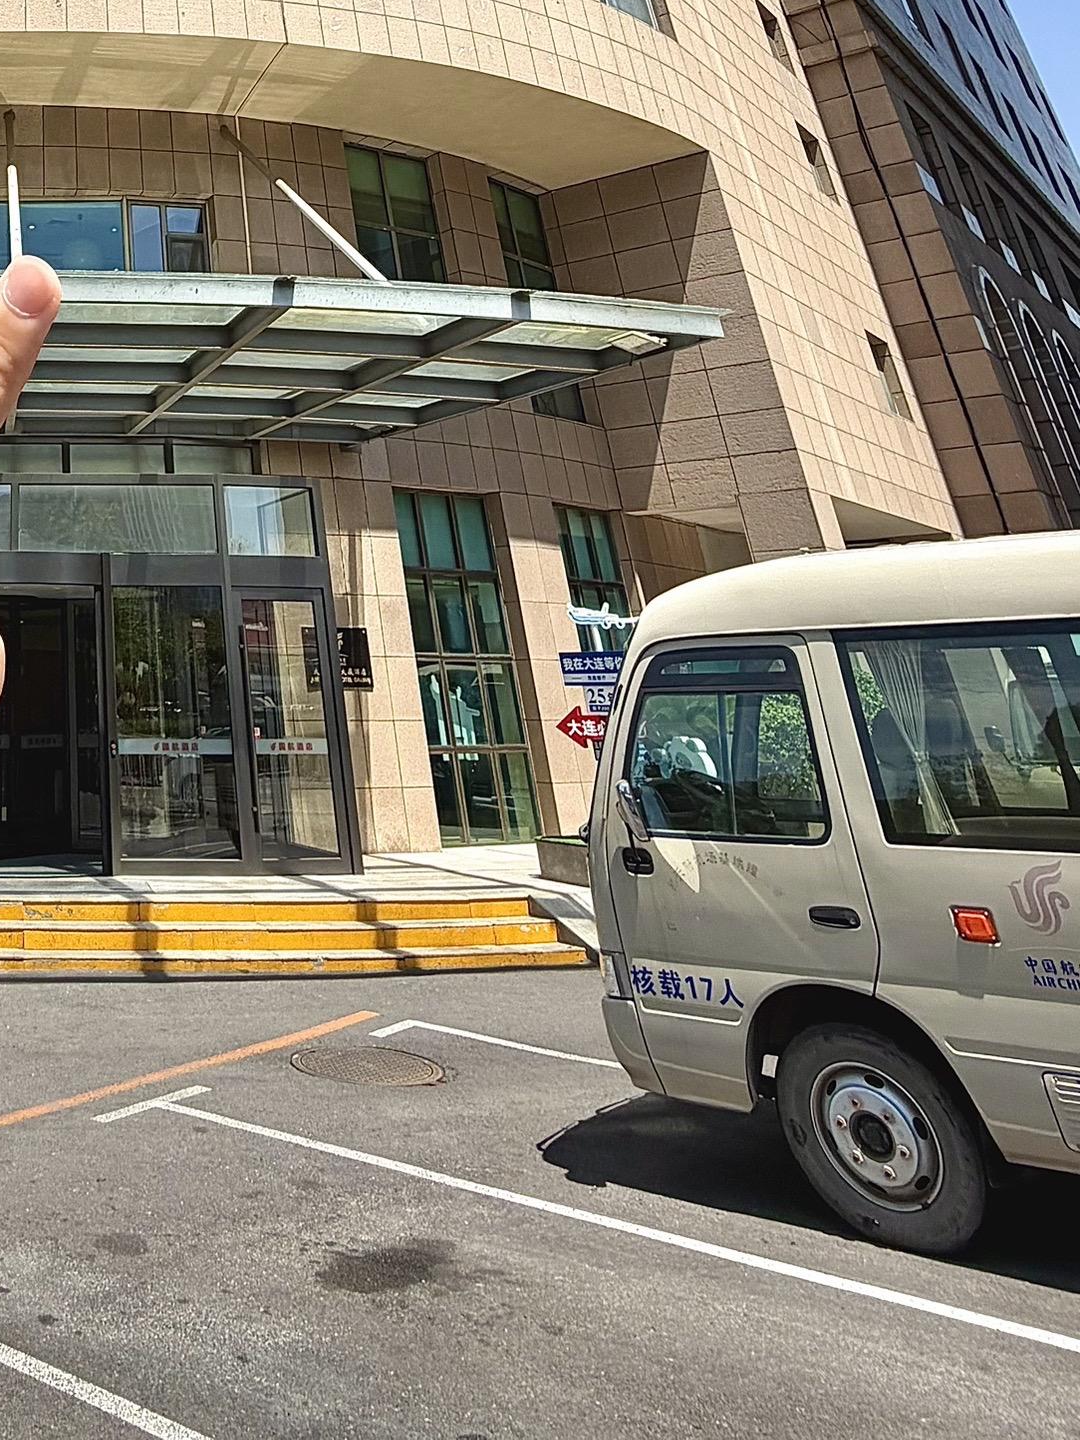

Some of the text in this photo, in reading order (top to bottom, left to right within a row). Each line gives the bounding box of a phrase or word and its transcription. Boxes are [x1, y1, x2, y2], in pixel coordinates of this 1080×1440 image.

[1024, 955, 1080, 977] 中国航
[631, 964, 745, 1009] 核载17人
